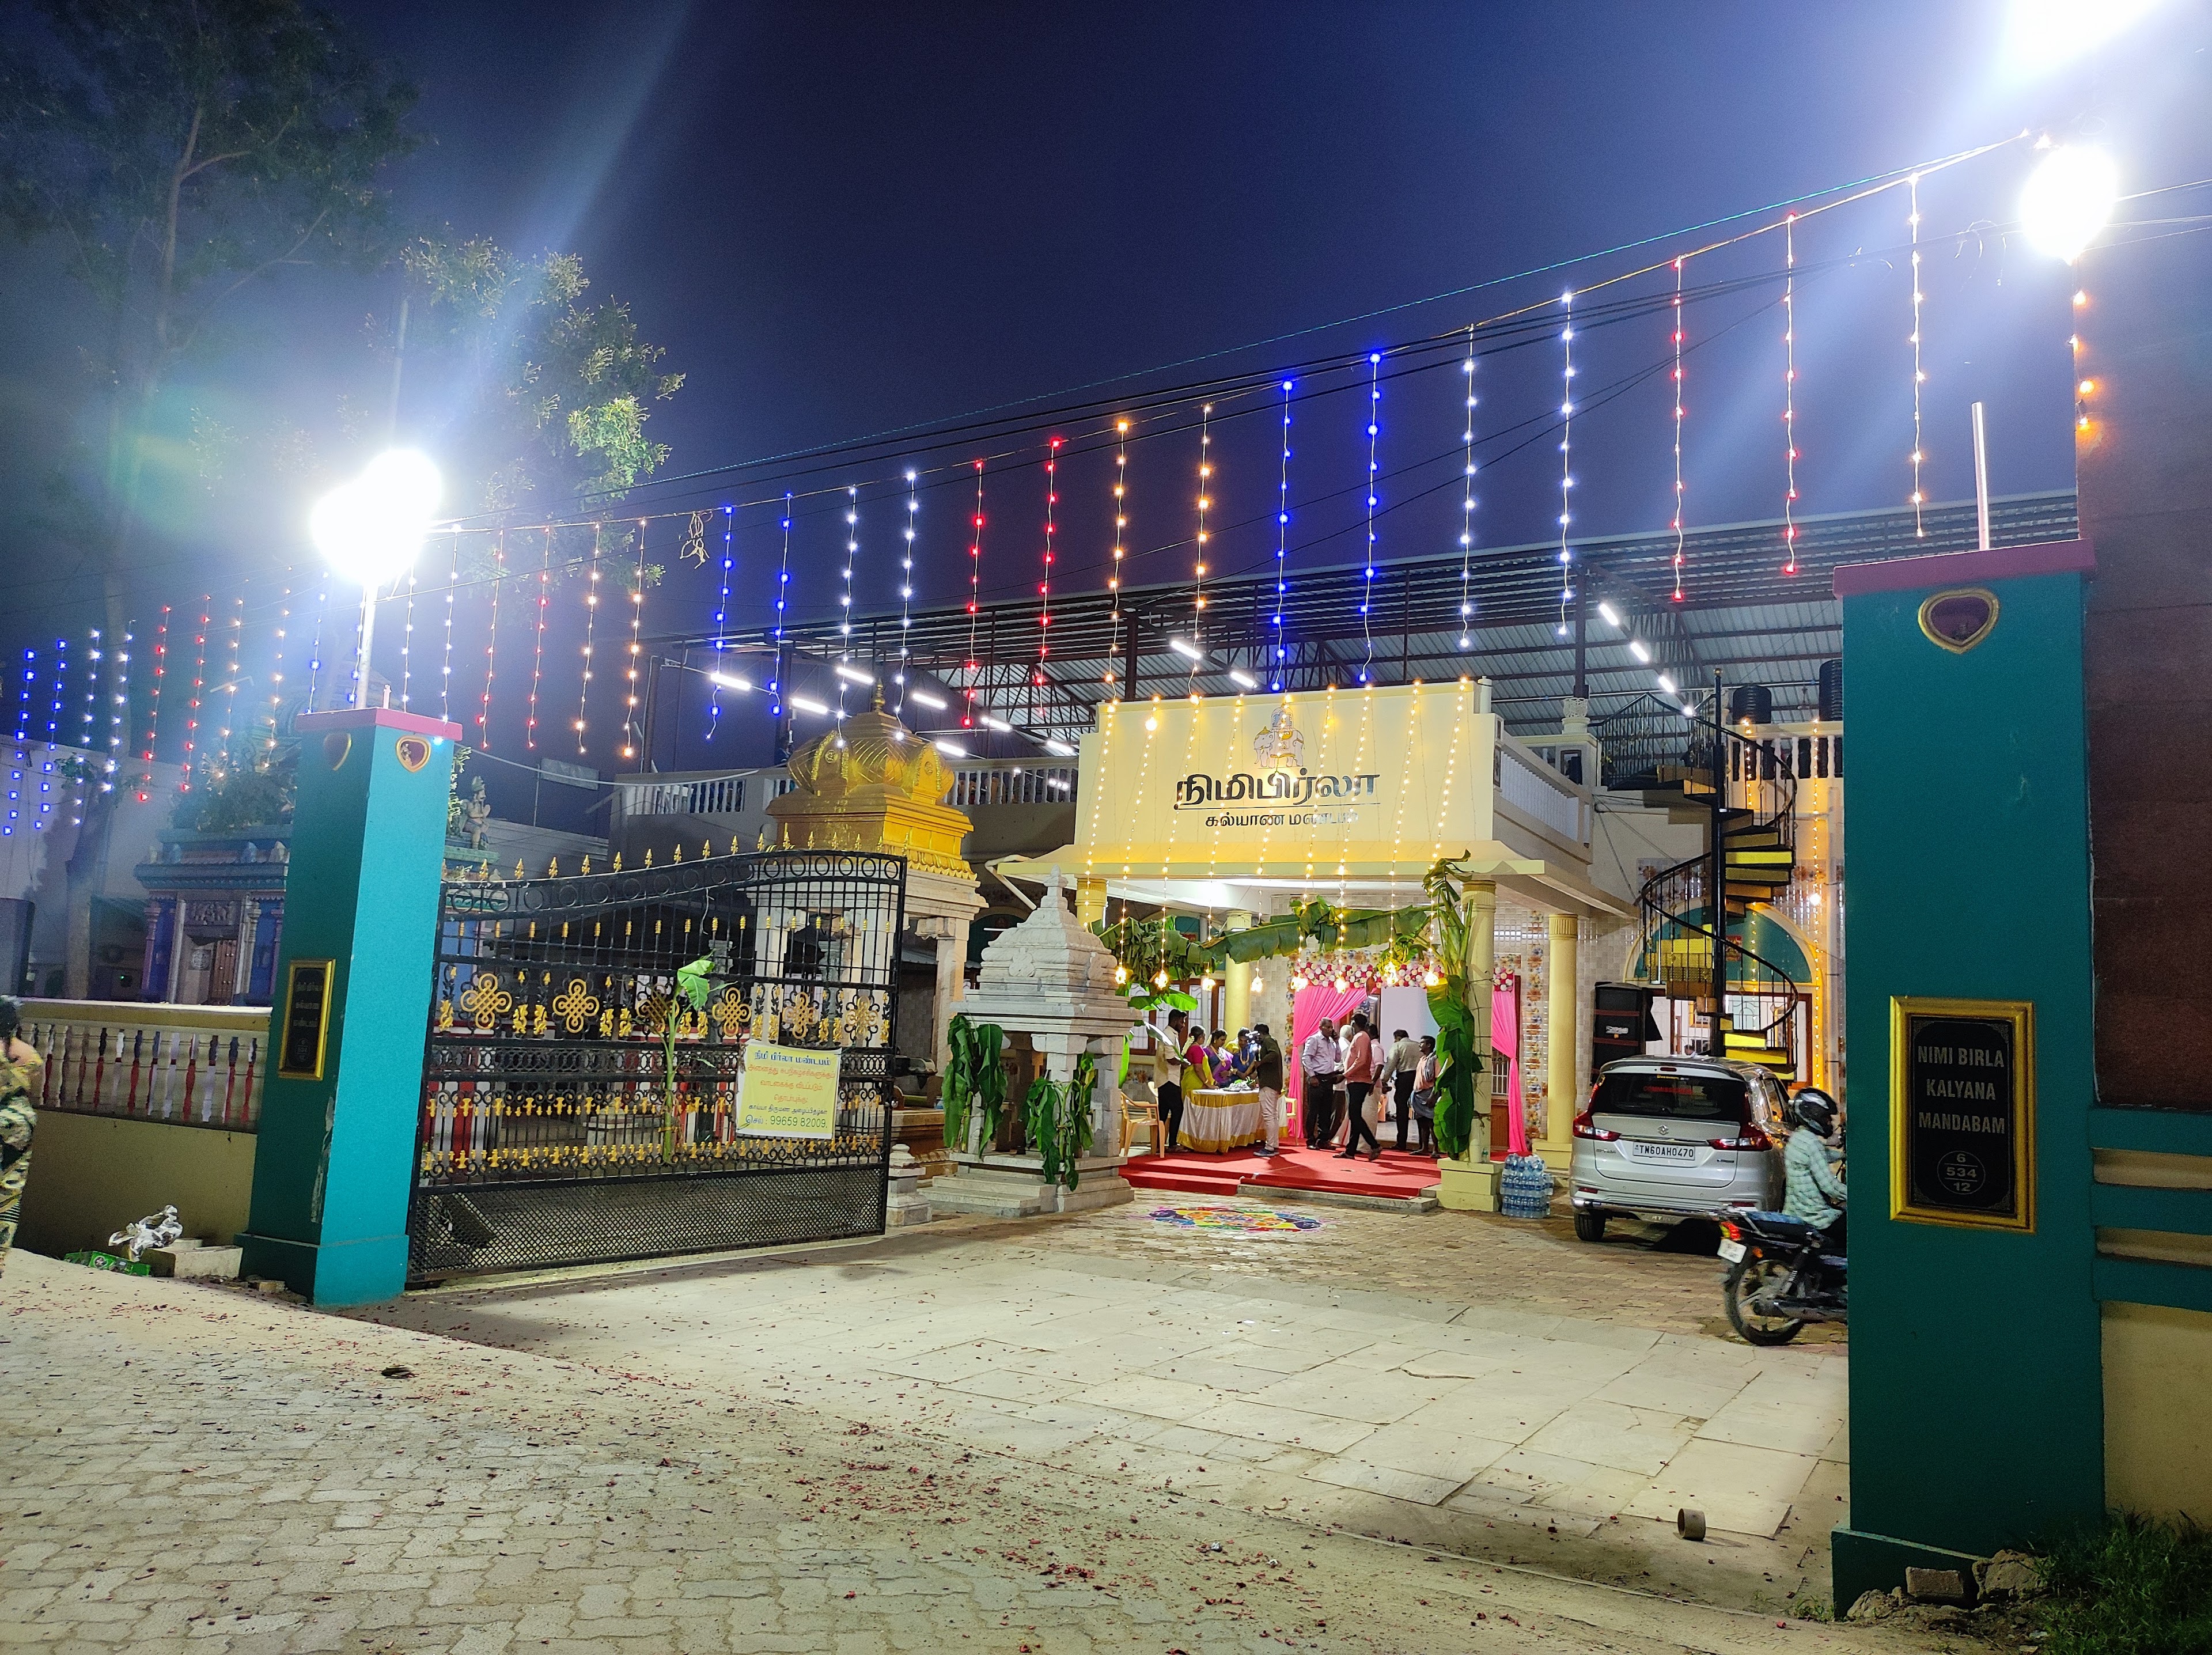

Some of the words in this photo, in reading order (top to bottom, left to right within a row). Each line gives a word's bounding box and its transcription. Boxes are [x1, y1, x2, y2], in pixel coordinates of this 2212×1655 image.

[1205, 812, 1285, 827] கல்யாண
[754, 1050, 768, 1060] நிமி
[771, 1052, 793, 1062] பிர்லா
[796, 1055, 831, 1066] மண்டபம்
[1917, 1046, 1953, 1065] NIMI
[1958, 1048, 2005, 1067] BIRLA
[1926, 1079, 1996, 1100] KALYANA
[770, 1115, 798, 1126] 99659
[1919, 1112, 2005, 1134] MANDABAM
[1639, 1145, 1694, 1158] TN60AH0470
[1957, 1153, 1966, 1163] 6
[1946, 1167, 1977, 1178] 534
[1953, 1181, 1971, 1192] 12
